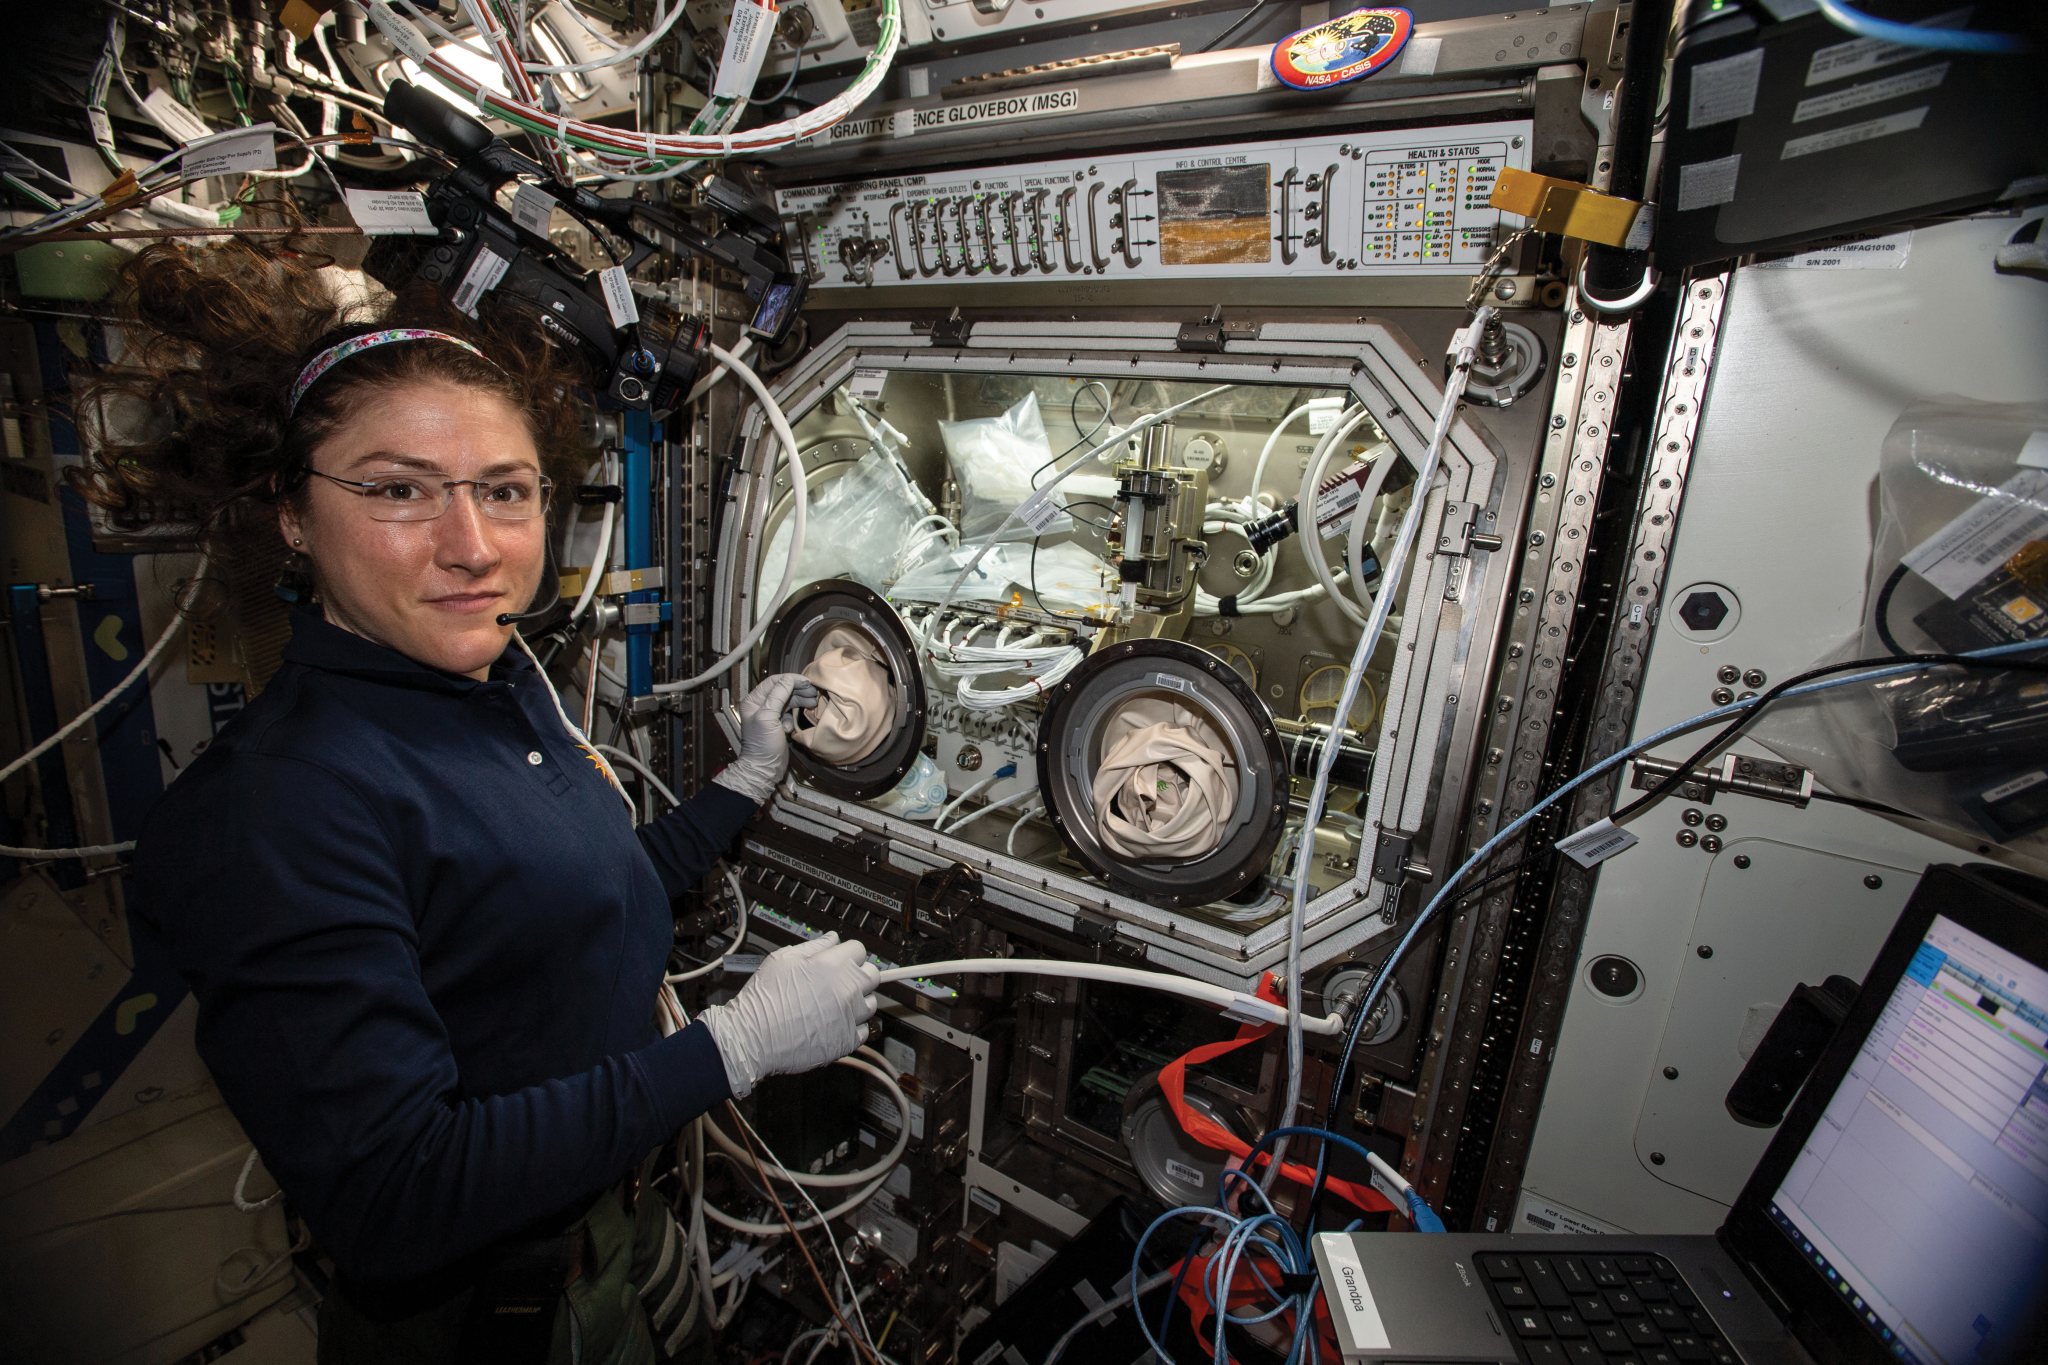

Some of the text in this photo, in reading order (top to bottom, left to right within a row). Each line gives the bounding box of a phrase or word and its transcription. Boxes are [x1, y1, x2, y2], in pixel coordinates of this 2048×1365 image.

[733, 9, 743, 34] DATA-J2
[1305, 60, 1371, 85] NASA CASIS
[888, 106, 944, 131] SENCE
[948, 97, 1028, 123] GLOVEBOX
[1031, 91, 1077, 112] (MSG)
[1408, 146, 1480, 159] HEALTH & STATUS
[202, 160, 227, 169] Camcorder
[1176, 160, 1188, 169] INFO
[1198, 157, 1222, 167] CONTROL
[1225, 155, 1248, 165] CENTRE
[200, 166, 231, 175] Compartment
[782, 176, 926, 198] COMMAND AND MONITORING PANEL (CMP)
[985, 181, 1008, 190] FUNCTIONS
[1024, 176, 1070, 187] SPECIAL FUNCTIONS
[906, 185, 968, 198] EXPERIMENT POWER OUTLETS
[1832, 233, 1855, 241] Rack
[540, 314, 580, 346] Canon
[1323, 495, 1339, 505] Camera
[767, 849, 899, 909] POWER DISTRIBUTION AND CONVERSION
[1545, 1208, 1558, 1218] FCF
[1559, 1214, 1580, 1227] Lower
[1581, 1223, 1598, 1234] Rack
[1563, 1224, 1574, 1232] P/N
[1455, 1261, 1471, 1287] ZBook
[1341, 1266, 1365, 1312] Grandpa
